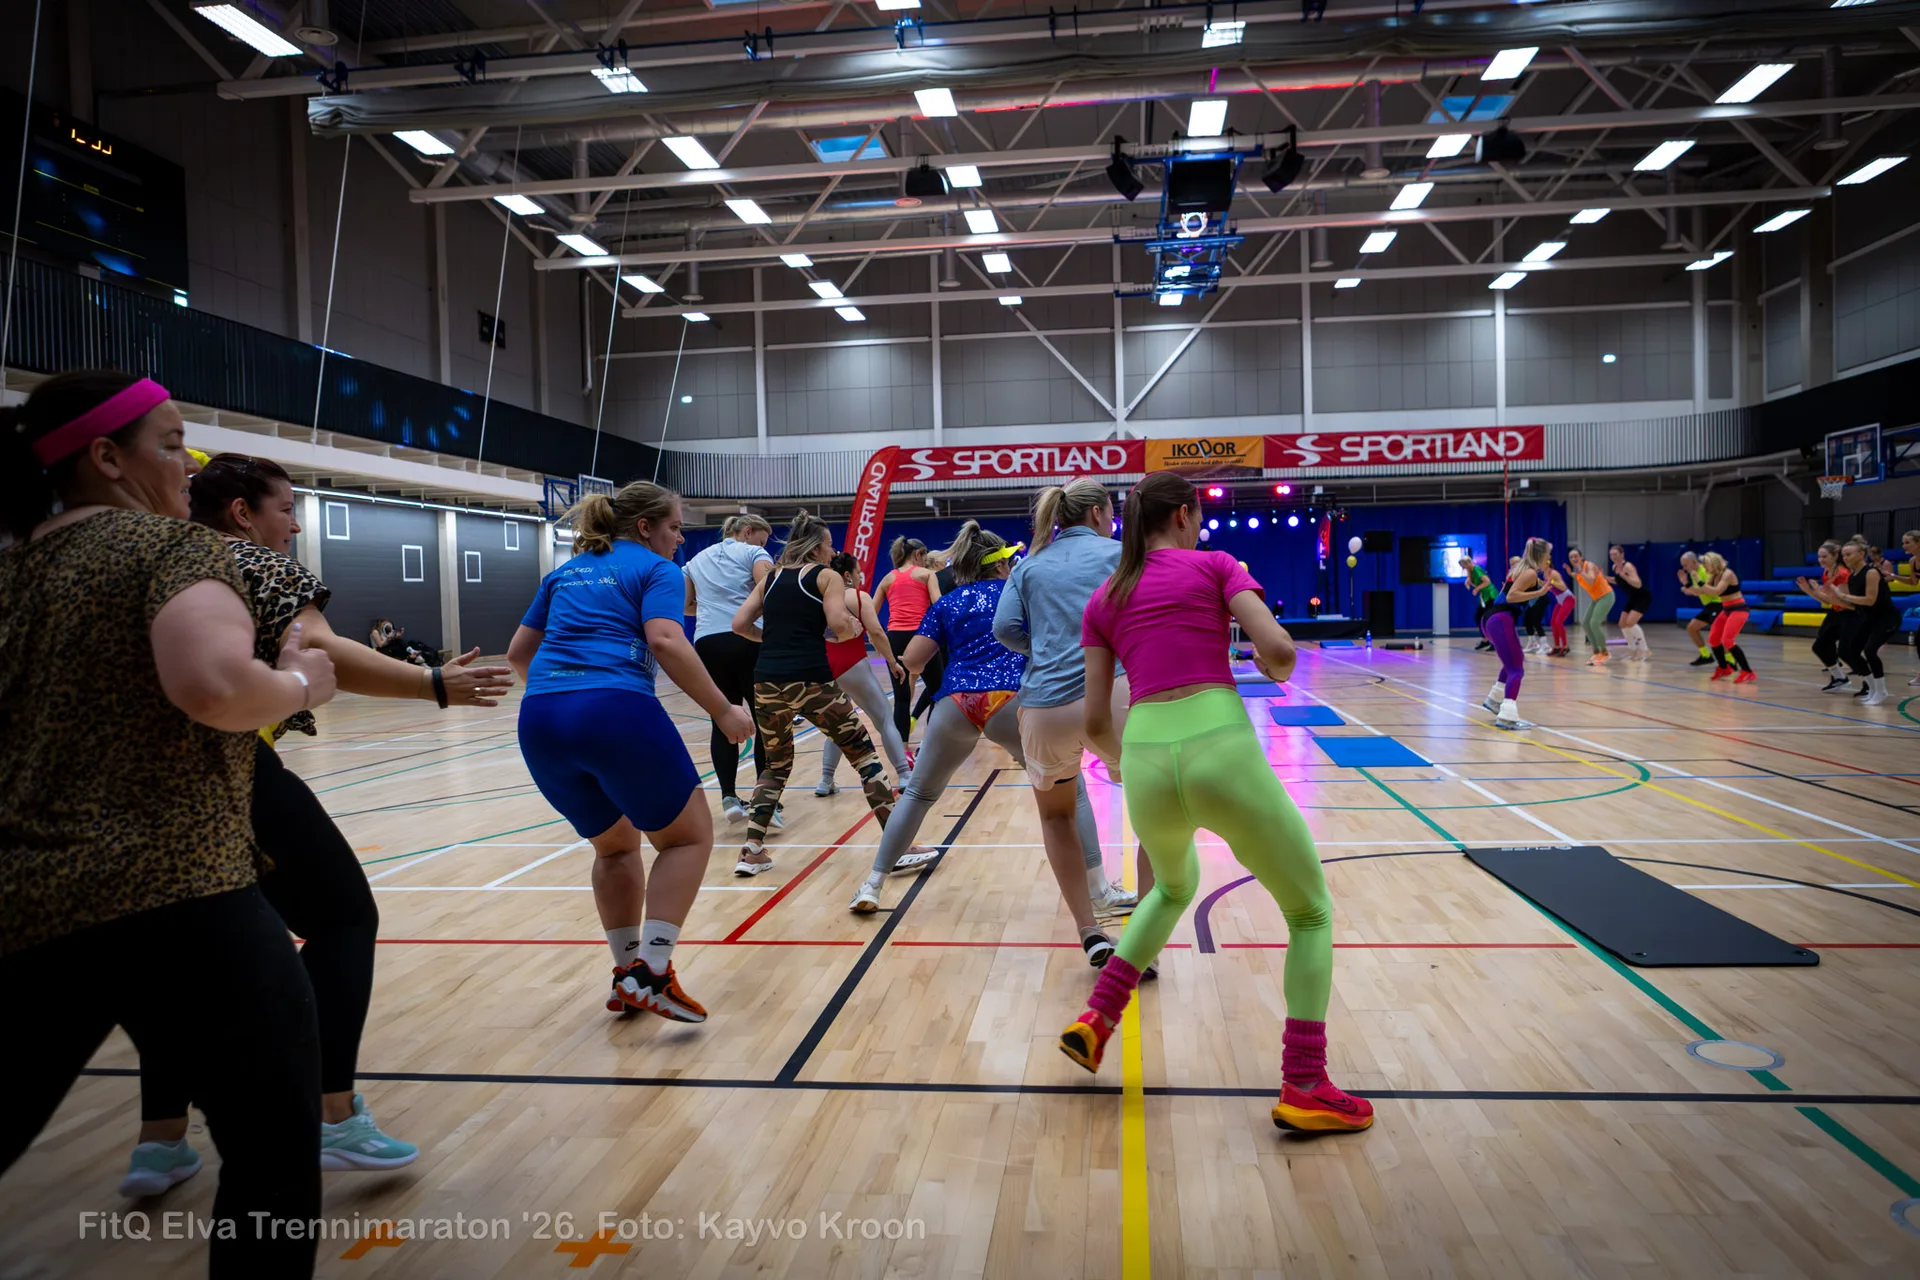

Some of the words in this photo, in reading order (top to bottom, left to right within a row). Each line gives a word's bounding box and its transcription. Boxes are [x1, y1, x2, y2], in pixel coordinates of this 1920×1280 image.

[952, 445, 1128, 475] SPORTLAND
[1171, 439, 1237, 457] IKODOR
[1340, 431, 1525, 462] SPORTLAND
[853, 461, 887, 562] SPORTLAND
